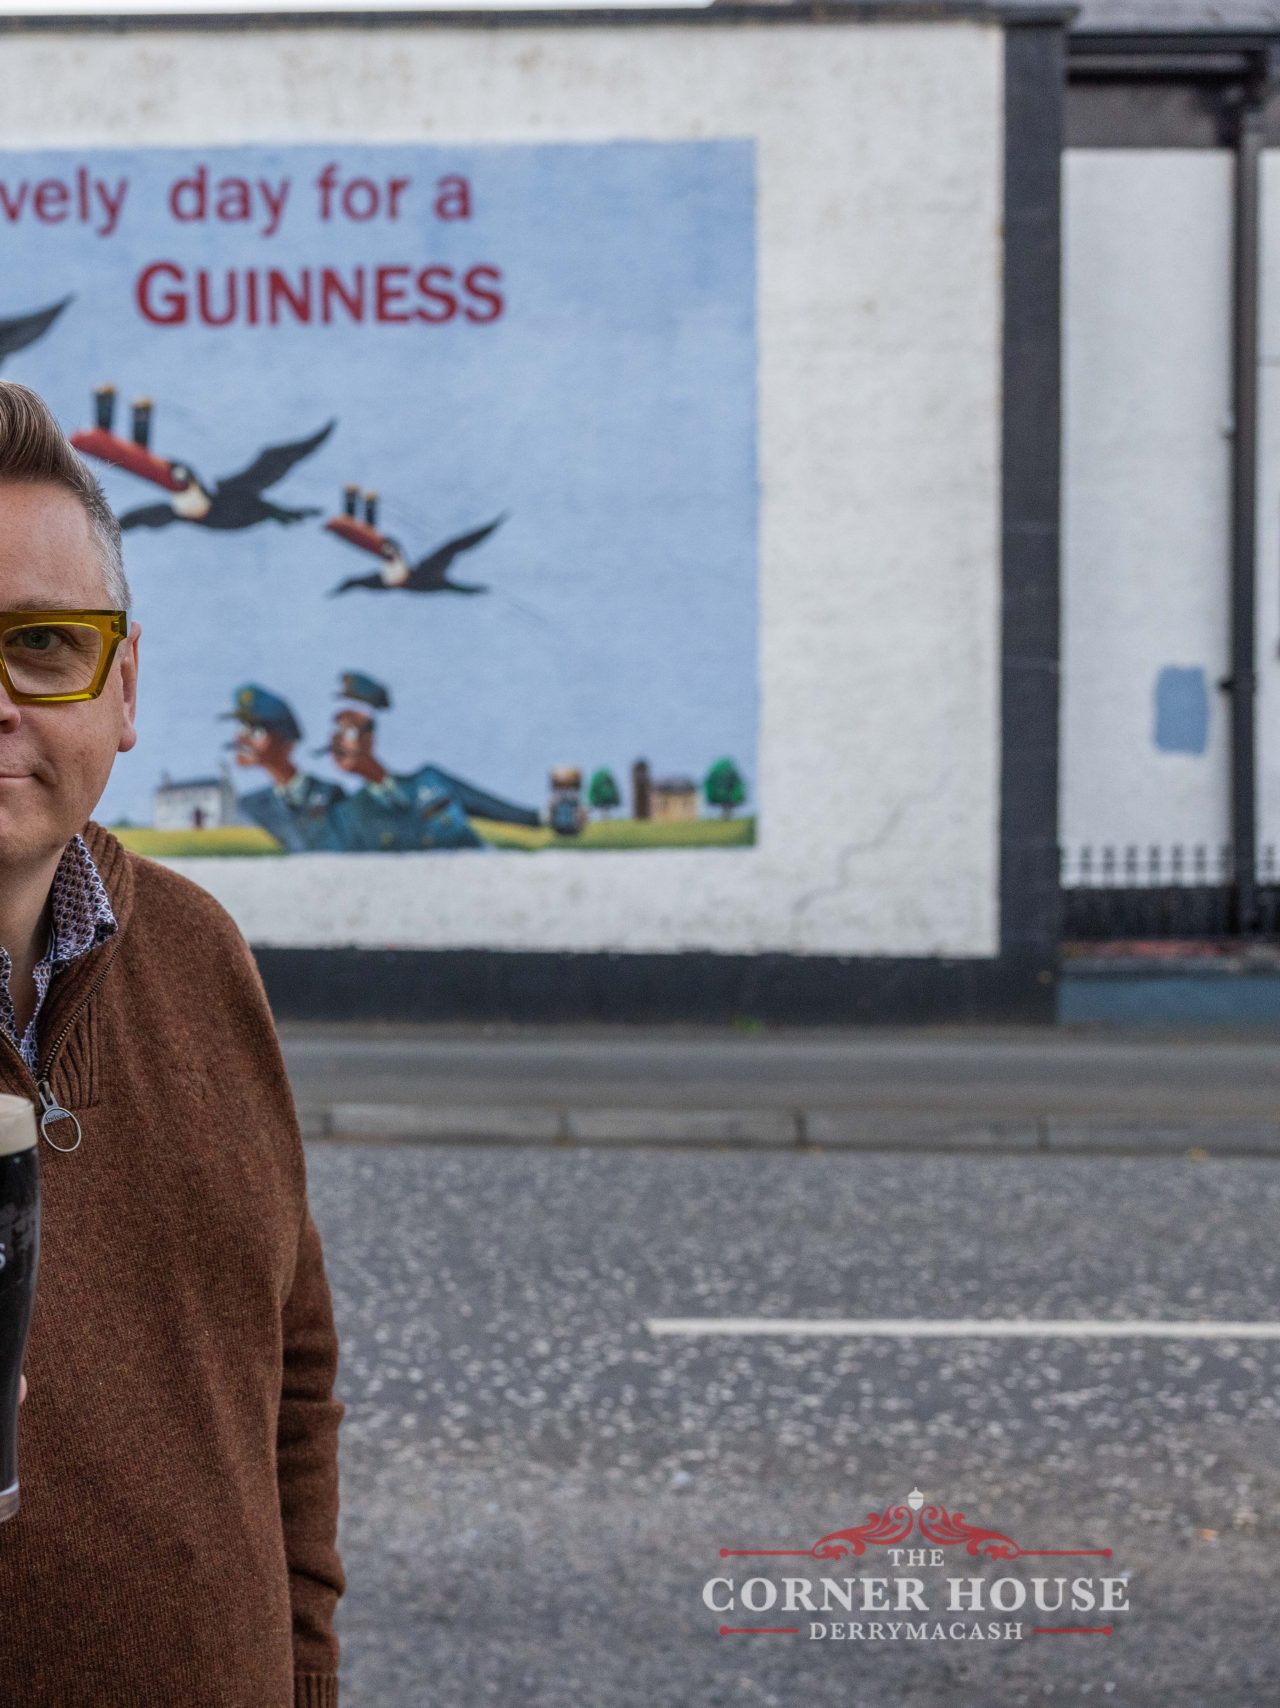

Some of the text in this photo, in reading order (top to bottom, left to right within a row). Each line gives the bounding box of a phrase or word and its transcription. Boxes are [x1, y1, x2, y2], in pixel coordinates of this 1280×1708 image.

[169, 164, 290, 237] day
[316, 162, 410, 221] for
[433, 174, 473, 220] a
[133, 259, 506, 328] GUINNESS
